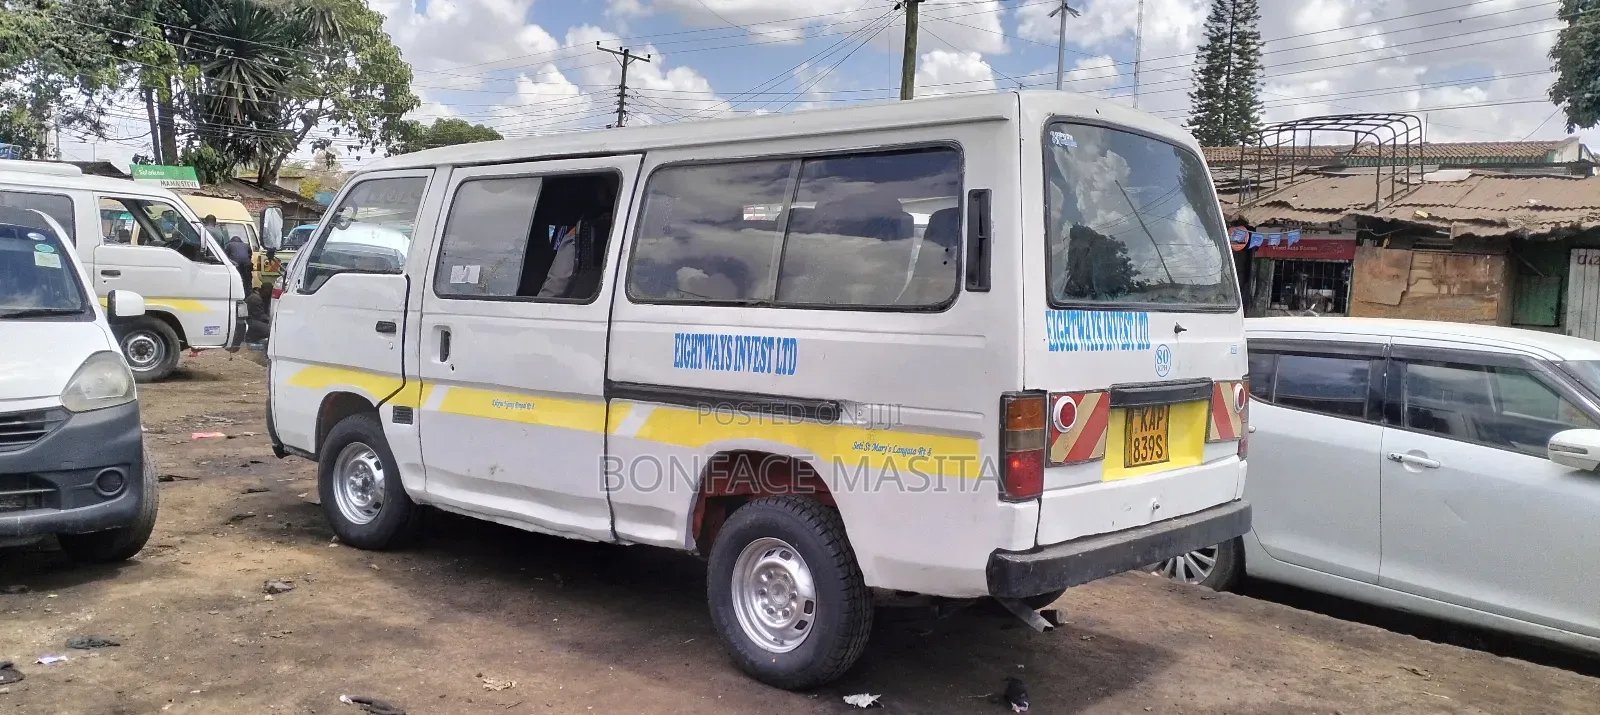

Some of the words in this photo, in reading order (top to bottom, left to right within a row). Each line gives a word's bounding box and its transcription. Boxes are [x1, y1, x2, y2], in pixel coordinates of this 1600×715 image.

[1045, 311, 1104, 352] EIGHTWAYS
[1103, 311, 1135, 351] INVEST
[1134, 312, 1151, 350] LTD
[673, 332, 733, 371] EIGHTWAYS
[733, 335, 775, 374] INVEST
[775, 337, 798, 376] LTD
[1156, 349, 1169, 364] 80
[1140, 404, 1165, 432] KAP
[871, 442, 891, 455] Mary's
[1133, 434, 1163, 463] 839S
